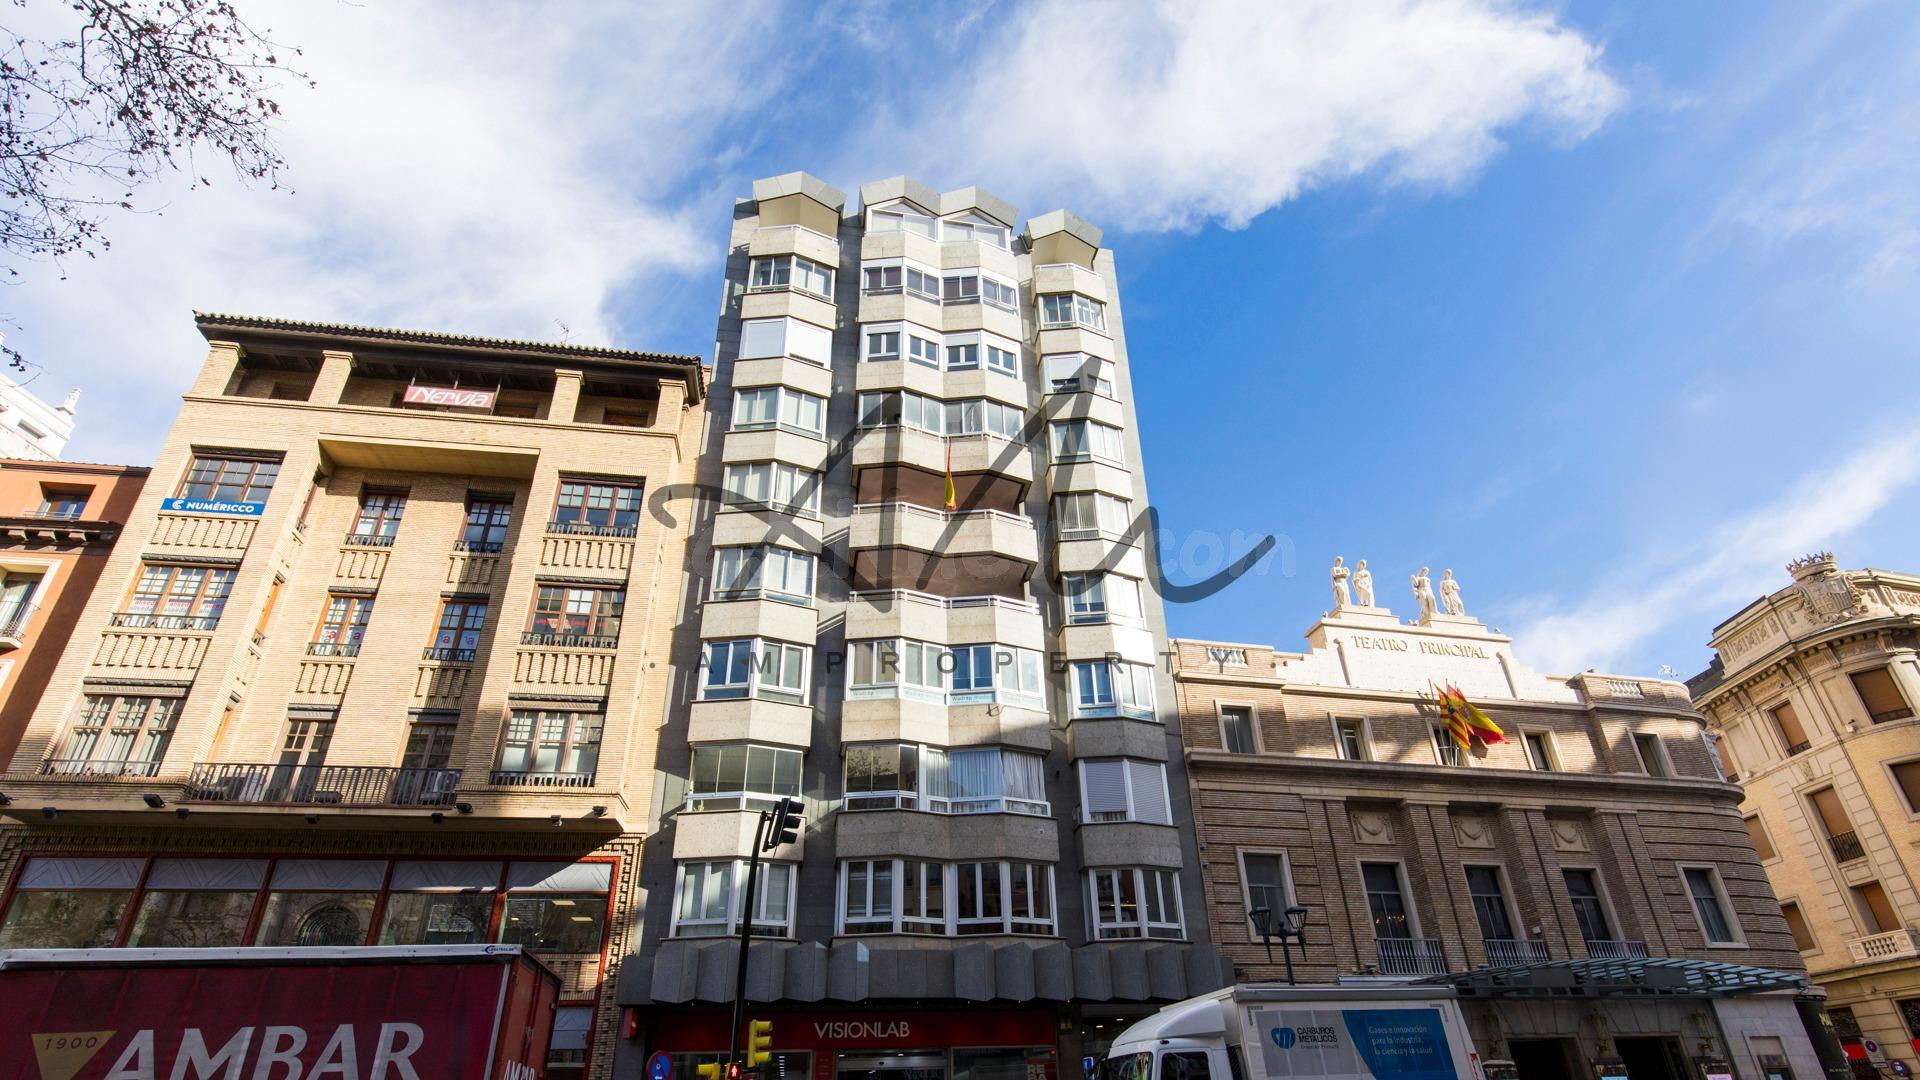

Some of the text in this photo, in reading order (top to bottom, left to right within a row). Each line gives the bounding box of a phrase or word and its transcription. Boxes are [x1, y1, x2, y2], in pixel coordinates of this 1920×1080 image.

[186, 501, 255, 513] NUMÉRICCO
[1351, 635, 1490, 659] TEATRO PRINCIPAL
[813, 1021, 911, 1039] VISIONLAB
[1297, 1026, 1335, 1035] CARBUROS
[43, 1035, 98, 1051] 1900
[103, 1022, 425, 1080] AMBAR
[1381, 1047, 1403, 1055] ciencia
